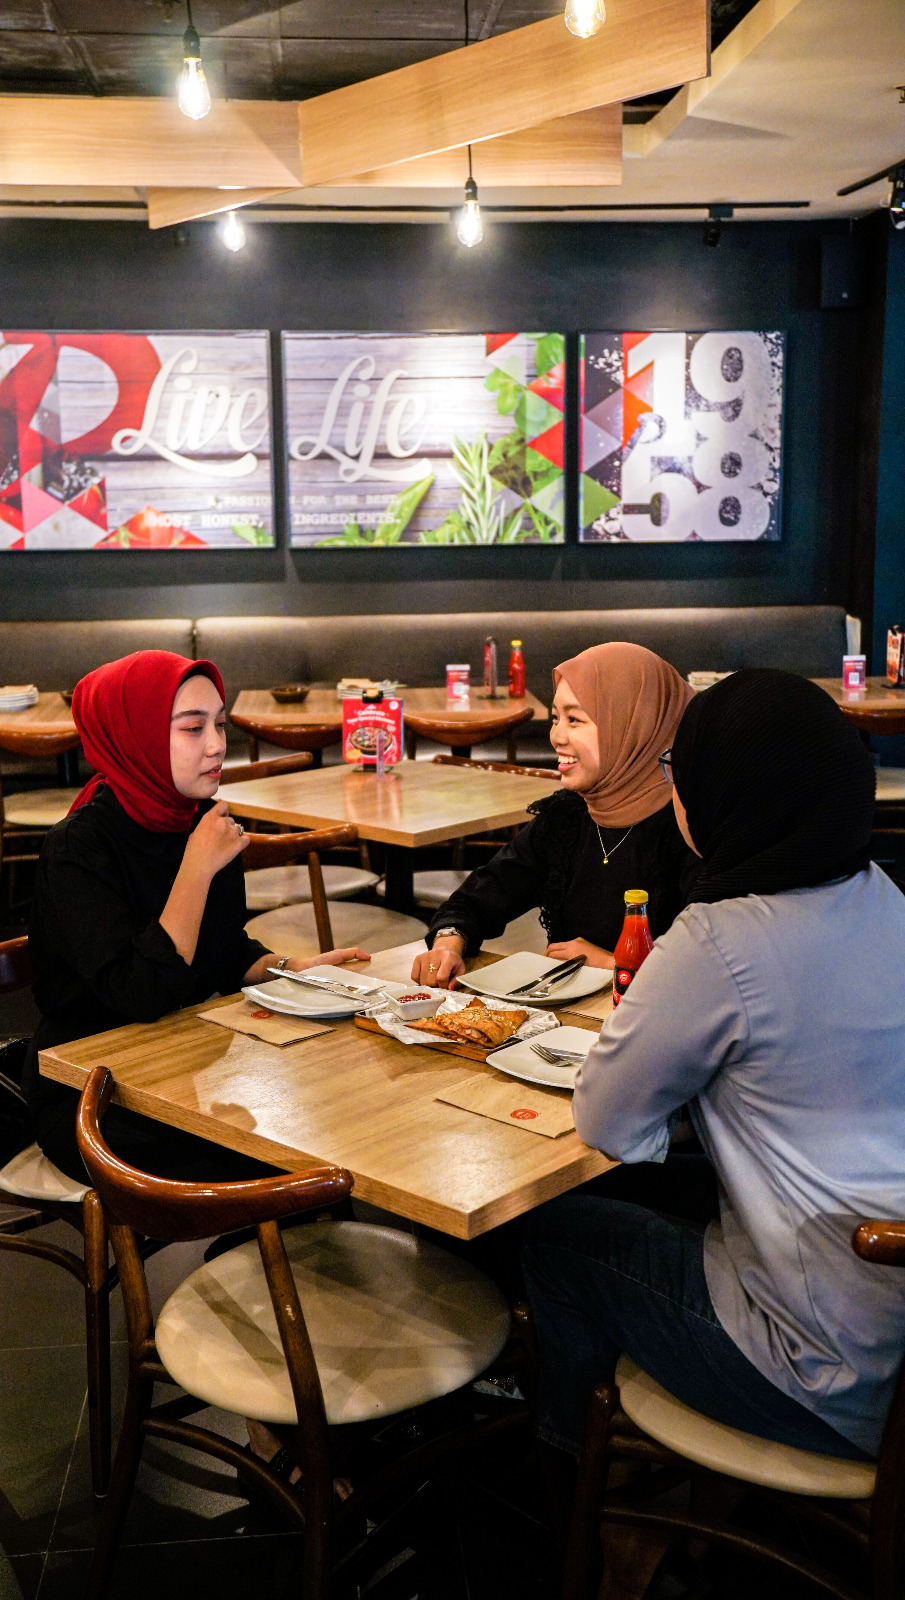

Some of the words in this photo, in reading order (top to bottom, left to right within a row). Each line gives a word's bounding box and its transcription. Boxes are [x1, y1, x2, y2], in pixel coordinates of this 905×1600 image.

[111, 347, 269, 478] Live
[290, 355, 433, 483] Life
[149, 513, 192, 528] MOST
[201, 513, 264, 528] HONEST,
[292, 513, 401, 525] INGREDIENTS.
[302, 494, 326, 505] FOR
[334, 494, 358, 505] THE
